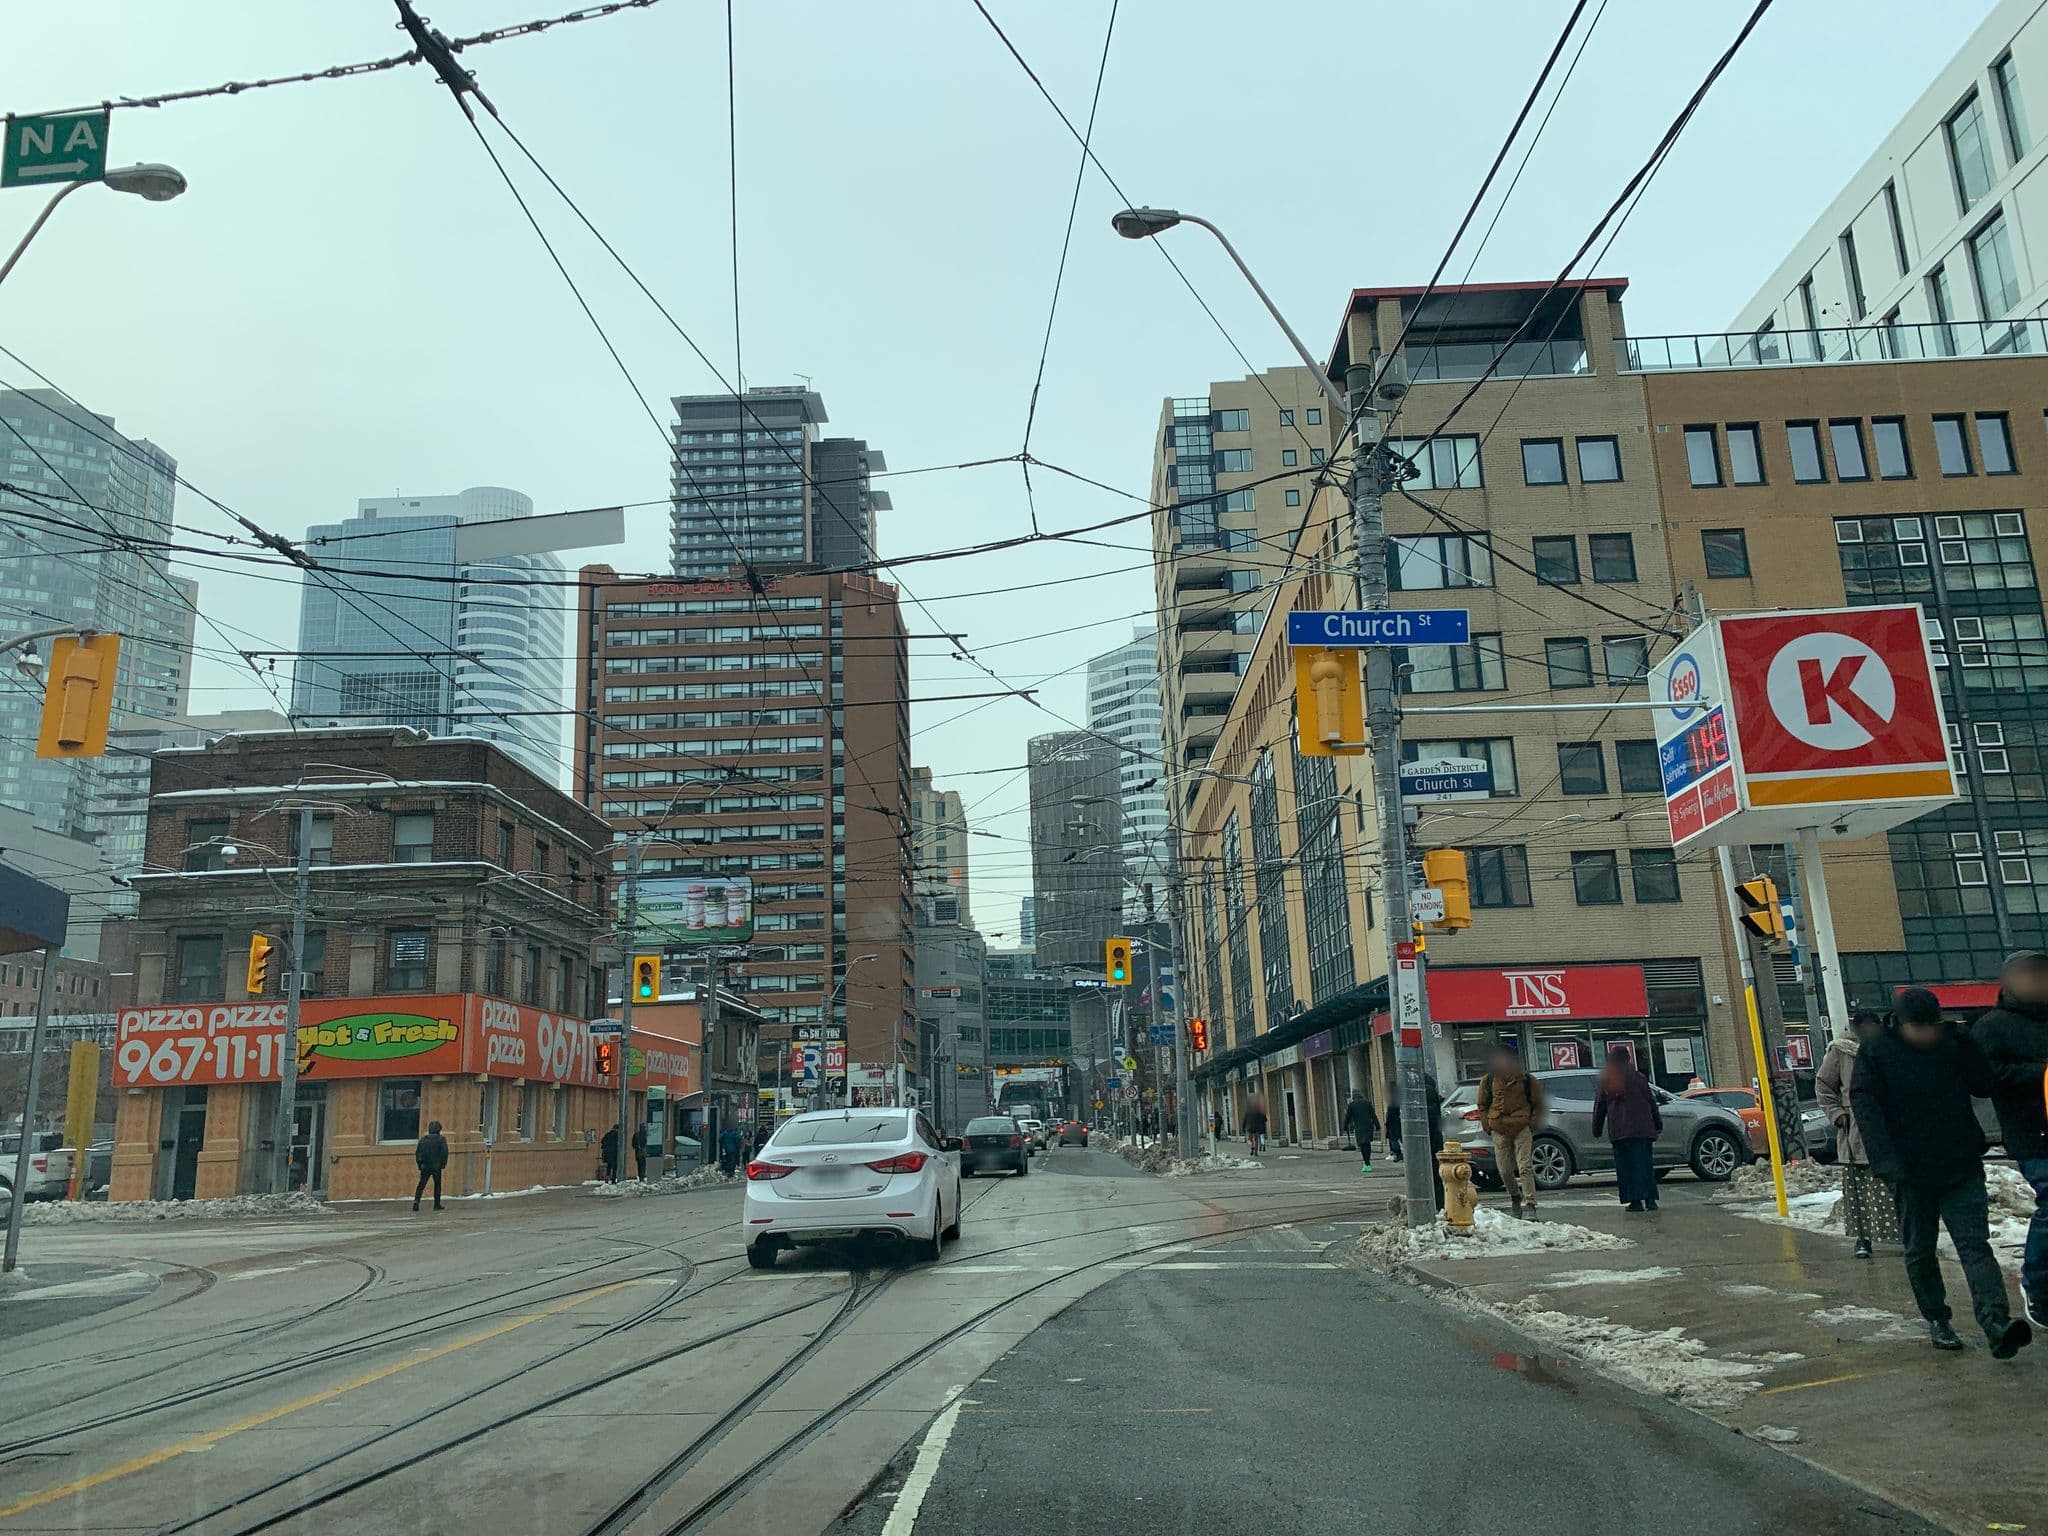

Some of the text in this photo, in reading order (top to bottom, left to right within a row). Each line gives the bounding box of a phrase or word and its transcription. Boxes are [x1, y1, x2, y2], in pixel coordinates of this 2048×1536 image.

[1323, 614, 1432, 637] Church St
[1797, 655, 1889, 739] K
[1407, 764, 1479, 776] GARDEN DISTRICT
[1665, 762, 1688, 785] service
[1415, 777, 1473, 791] Church St
[1412, 900, 1444, 912] STANDING
[1421, 892, 1432, 901] NO
[1504, 975, 1567, 1008] INS
[121, 1008, 203, 1041] pizza
[482, 999, 520, 1038] pizza
[372, 1018, 458, 1045] Fresh
[487, 1034, 526, 1072] pizza
